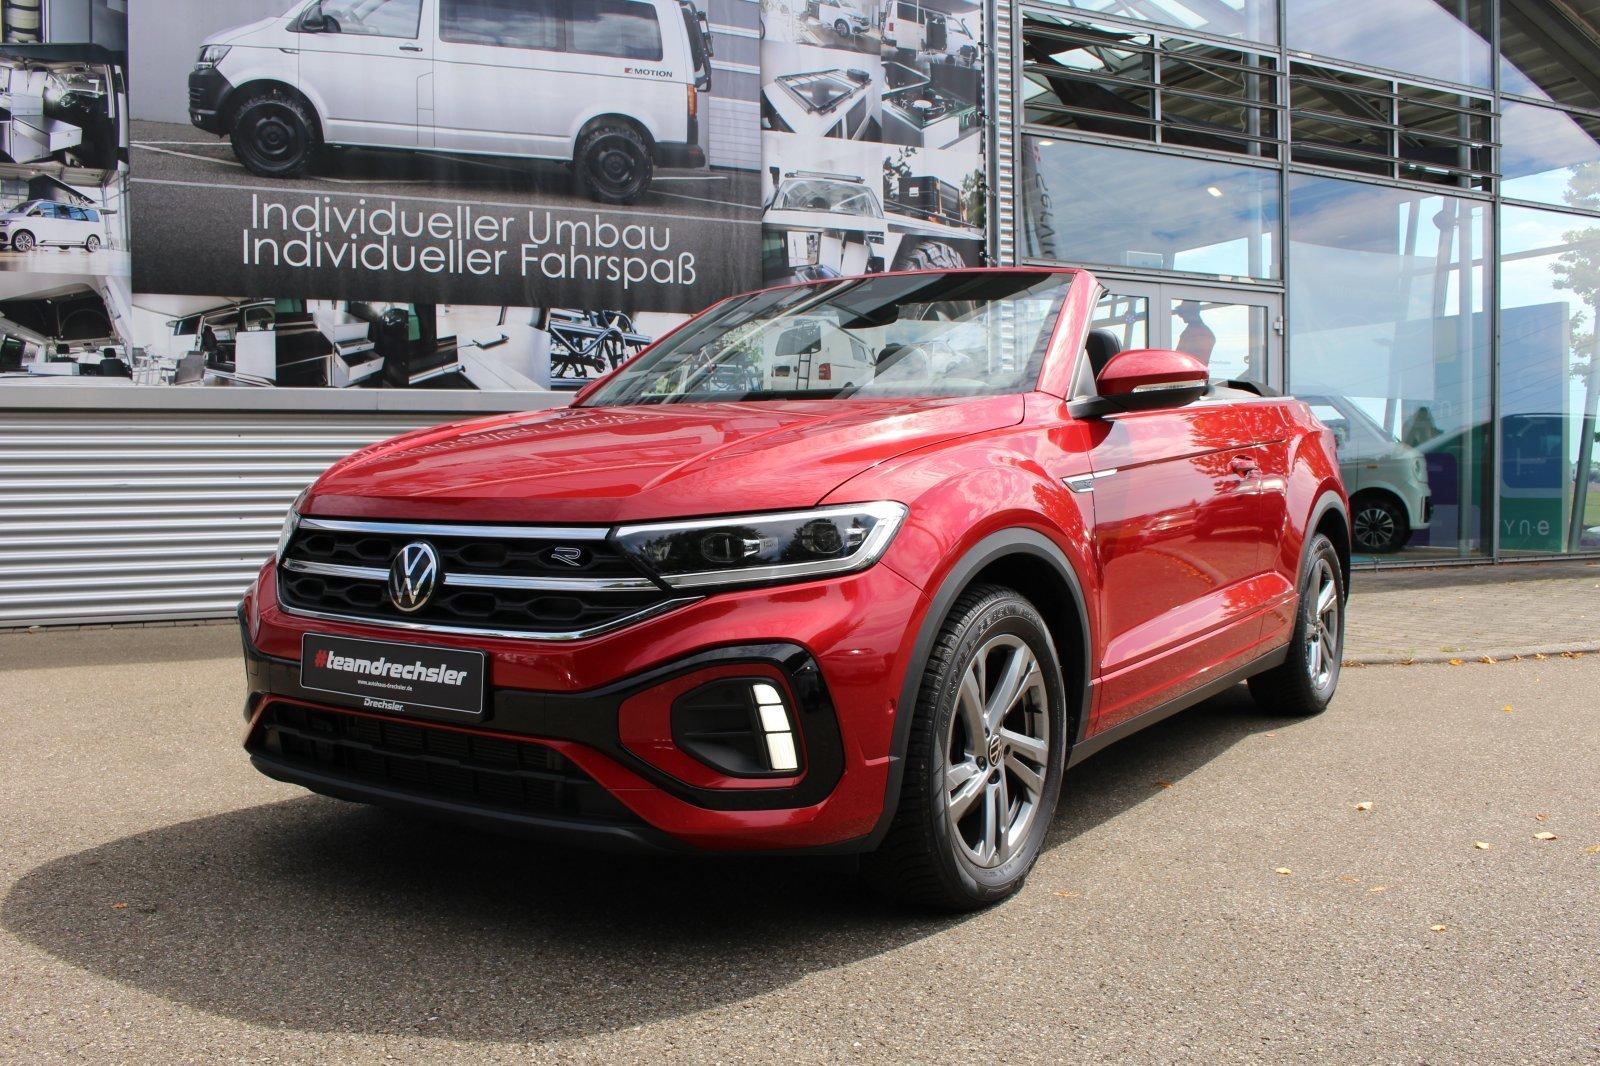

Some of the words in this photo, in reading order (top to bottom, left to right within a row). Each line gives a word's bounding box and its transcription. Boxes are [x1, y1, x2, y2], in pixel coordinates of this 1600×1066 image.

[251, 194, 514, 241] Individueller
[528, 211, 670, 251] Umbau
[243, 229, 507, 275] Individueller
[521, 244, 697, 289] Fahrspaß
[314, 650, 468, 685] #teamdrechsler
